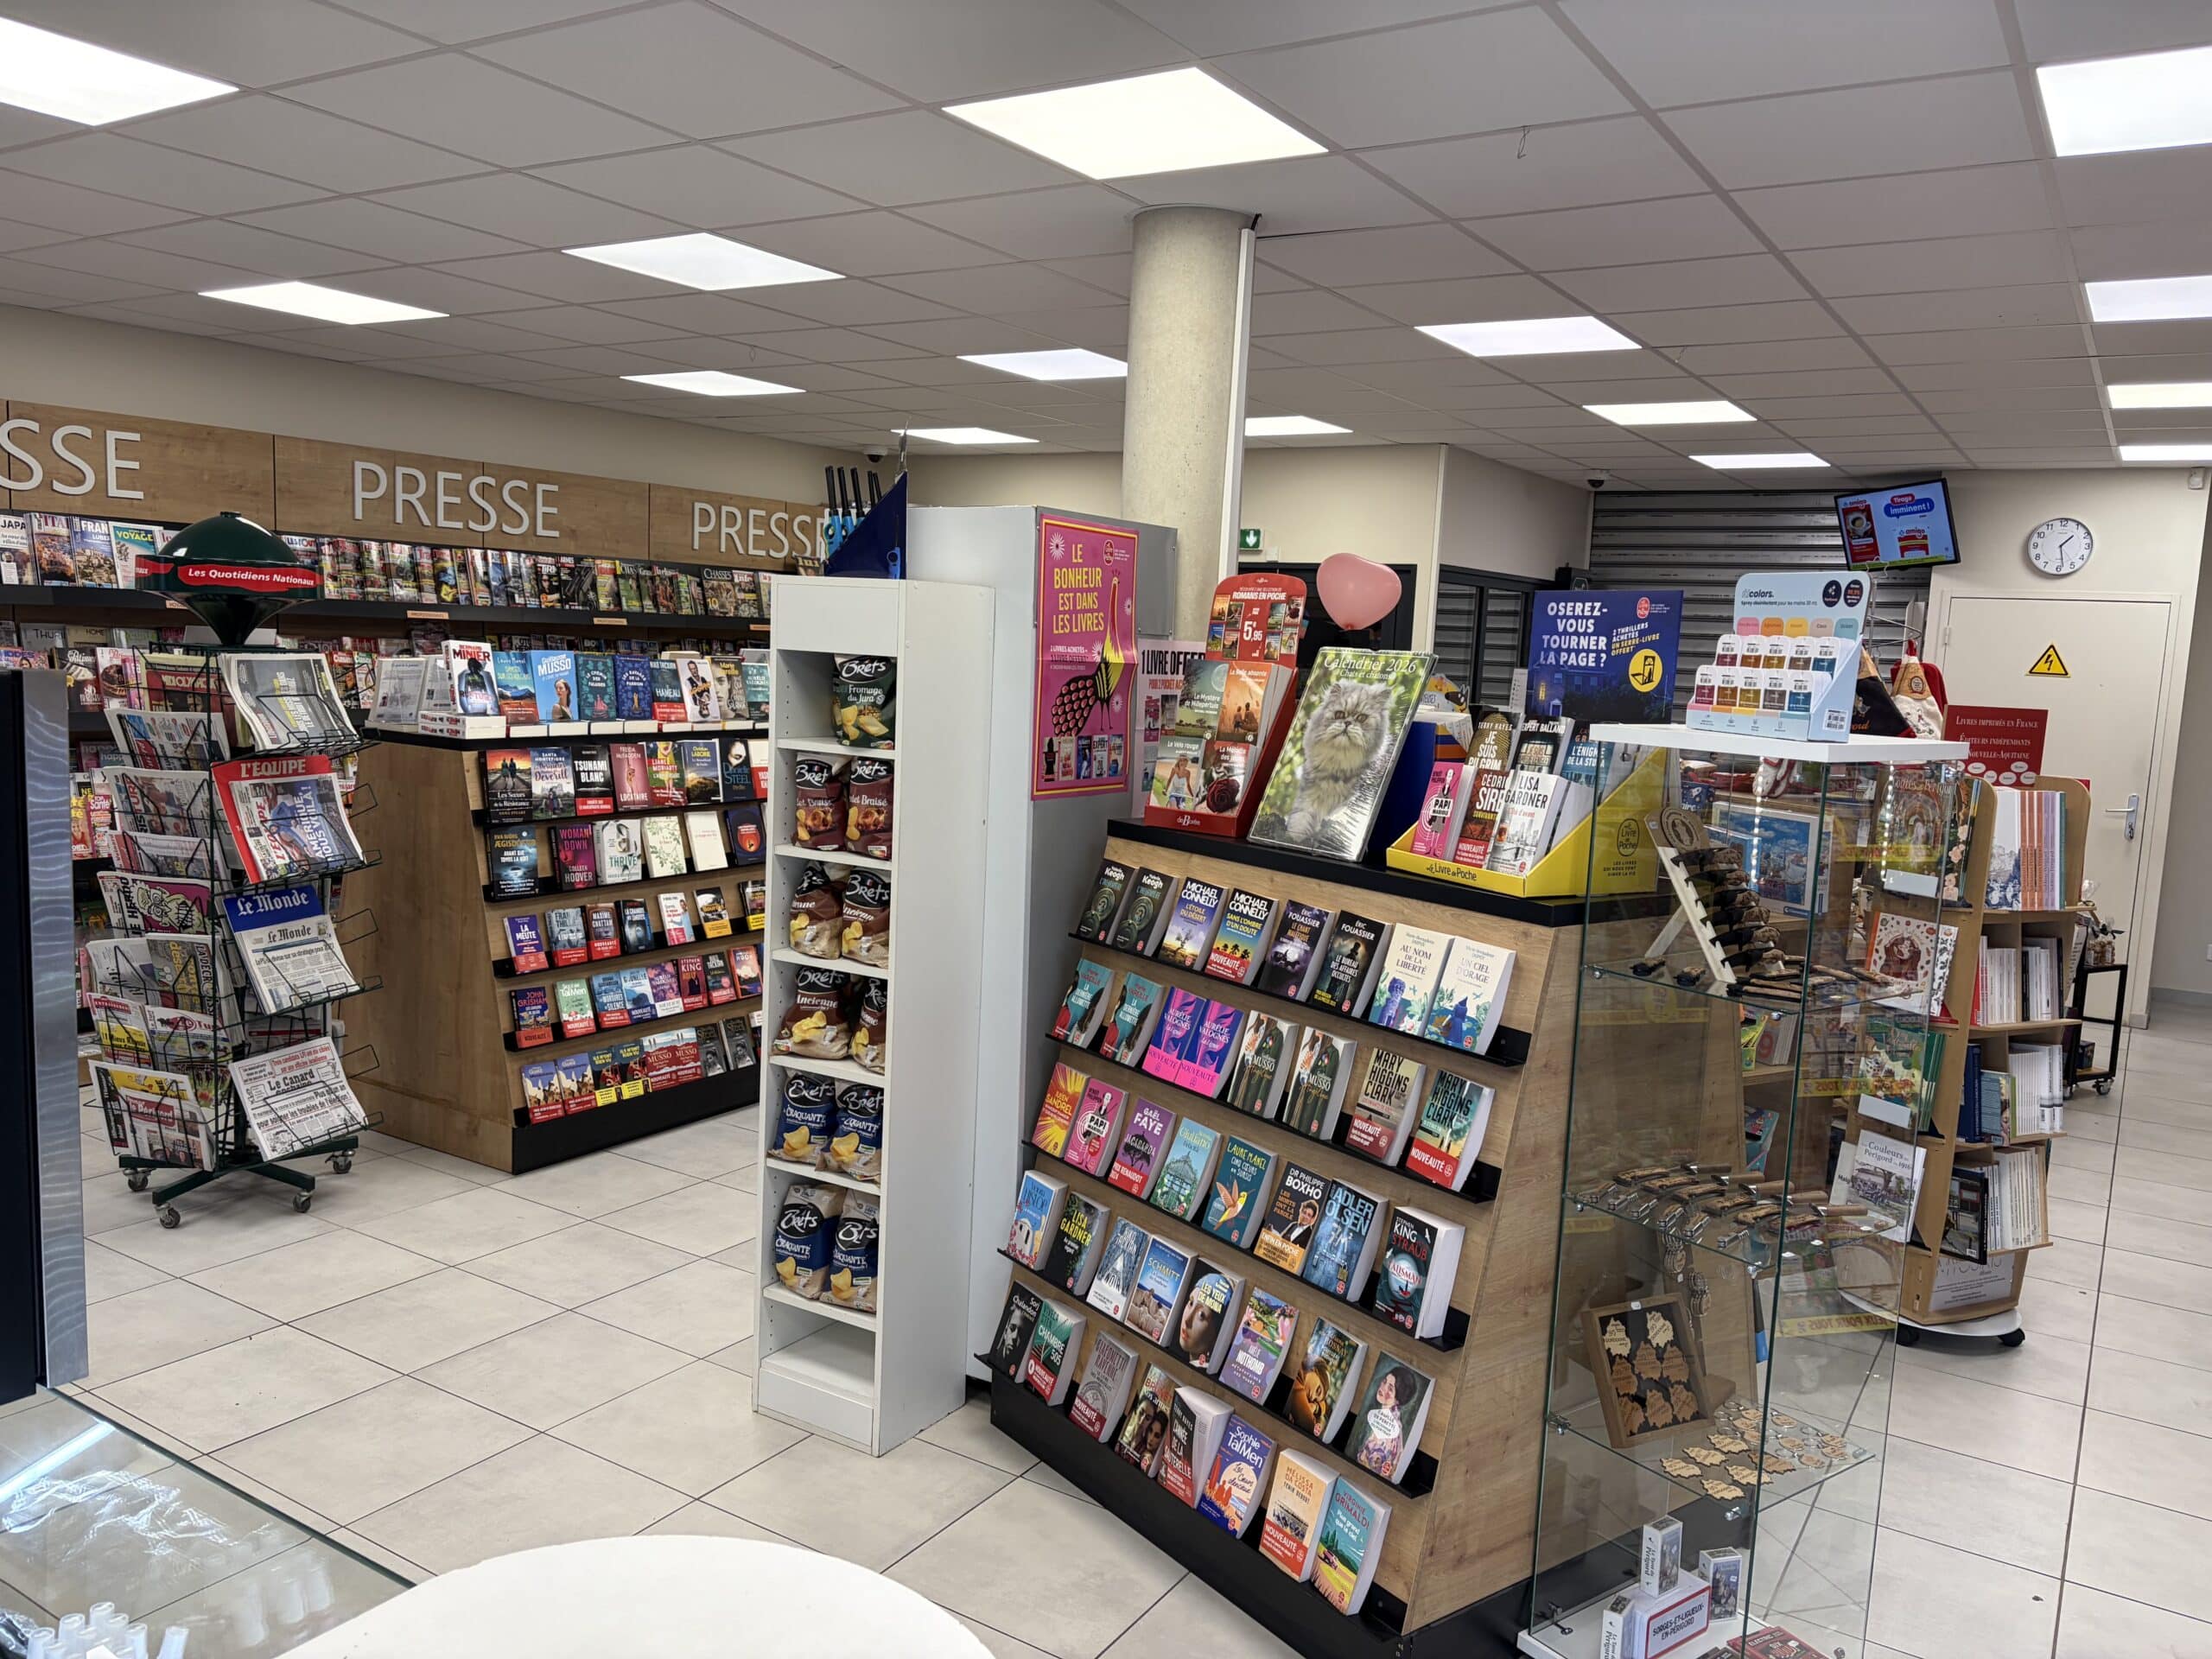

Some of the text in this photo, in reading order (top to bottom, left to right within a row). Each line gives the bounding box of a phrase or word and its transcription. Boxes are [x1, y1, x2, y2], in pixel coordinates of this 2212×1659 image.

[353, 461, 560, 538] PRESSE
[1891, 504, 1927, 515] Imminent
[1905, 527, 1926, 537] amigo
[1072, 543, 1084, 563] LE
[188, 568, 314, 586] Les Quotidiens Nationaux
[1054, 567, 1103, 589] BONHEUR
[1058, 592, 1098, 611] EST DANS
[1232, 591, 1258, 600] ROMANS
[1268, 592, 1287, 601] POCHE
[1547, 602, 1608, 616] OSEREZ-
[1053, 612, 1104, 634] LES LIVRES
[1557, 619, 1595, 632] VOUS
[1542, 635, 1607, 650] TOURNER
[453, 649, 491, 661] MINIER
[1540, 651, 1607, 667] LA PAGE ?
[537, 658, 571, 676] MUSSO
[1324, 656, 1417, 674] Calendrier 2026
[849, 684, 883, 696] Fromage
[857, 694, 874, 705] Jura
[1956, 715, 1978, 726] LIVRES
[2016, 718, 2038, 728] FRANCE
[1484, 731, 1497, 744] JE
[1478, 745, 1497, 758] SUIS
[574, 760, 607, 772] TSUNAMI
[1584, 759, 1605, 768] STUA
[581, 772, 604, 783] BLANC
[1519, 776, 1540, 791] LISA
[1433, 799, 1451, 810] PAPI
[1505, 789, 1548, 810] GARDNER
[559, 828, 590, 839] WOMAN
[564, 840, 588, 850] DOWN
[610, 856, 638, 867] THRIVE
[565, 872, 594, 882] HOOVER
[1104, 867, 1125, 881] Keogh
[1141, 874, 1163, 890] Keogh
[1186, 880, 1217, 899] MICHAEL
[237, 890, 309, 916] Le Monde
[1181, 890, 1218, 908] CONNELLY
[1234, 892, 1268, 911] MICHAEL
[1226, 913, 1242, 924] SANS
[1229, 901, 1268, 921] CONNELLY
[1288, 912, 1320, 928] FOUASSIER
[268, 925, 311, 943] Le Monde
[1341, 923, 1376, 941] FOUASSIER
[1210, 952, 1241, 970] NOUVEAUTÉ
[1400, 944, 1432, 961] AU NOM
[1414, 956, 1422, 965] LA
[681, 963, 702, 972] KING
[1396, 959, 1428, 976] LIBERTÉ
[1473, 962, 1491, 974] CIEL
[1165, 1015, 1192, 1031] VALOGNES
[1204, 1020, 1229, 1035] AURÉLIE
[1199, 1027, 1230, 1044] VALOGNES
[648, 1052, 671, 1064] MUSSO
[676, 1048, 696, 1058] MUSSO
[1374, 1050, 1402, 1073] MARY
[1253, 1056, 1274, 1072] MUSSO
[268, 1069, 315, 1090] Le Canard
[1180, 1063, 1216, 1084] NOUVEAUTÉ
[1309, 1073, 1332, 1091] MUSSO
[1369, 1065, 1410, 1092] HIGGINS
[1437, 1071, 1466, 1095] MARY
[1364, 1081, 1395, 1105] CLARK
[1431, 1086, 1472, 1116] HIGGINS
[1089, 1115, 1107, 1130] PAPI
[1143, 1107, 1160, 1122] GAËL
[1426, 1103, 1456, 1129] CLARK
[1134, 1113, 1163, 1135] FAYE
[1353, 1118, 1382, 1137] NOUVEAUTÉ
[1868, 1141, 1904, 1159] Couleurs
[1410, 1147, 1446, 1173] NOUVEAUTÉ
[1285, 1175, 1322, 1200] BOXHO
[1289, 1167, 1325, 1190] DR PHILIPPE
[1332, 1186, 1376, 1219] ADLER
[1072, 1210, 1088, 1230] LISA
[1325, 1199, 1370, 1236] OLSEN
[1395, 1216, 1415, 1229] STEPHEN
[1060, 1221, 1092, 1246] GARDNER
[1393, 1224, 1418, 1243] KING
[1392, 1236, 1428, 1262] STRAUB
[1147, 1257, 1180, 1281] SCHMITT
[1013, 1295, 1038, 1319] Chalandon
[1038, 1325, 1066, 1353] CHAMBRE
[1050, 1351, 1062, 1366] 505
[1236, 1353, 1265, 1374] NOTHOMB
[1236, 1426, 1261, 1451] Sophie
[1227, 1433, 1264, 1469] TalMen
[1294, 1478, 1313, 1497] COSTA
[1335, 1495, 1370, 1529] GRIMALDI
[1265, 1524, 1298, 1554] NOUVEAUTÉ
